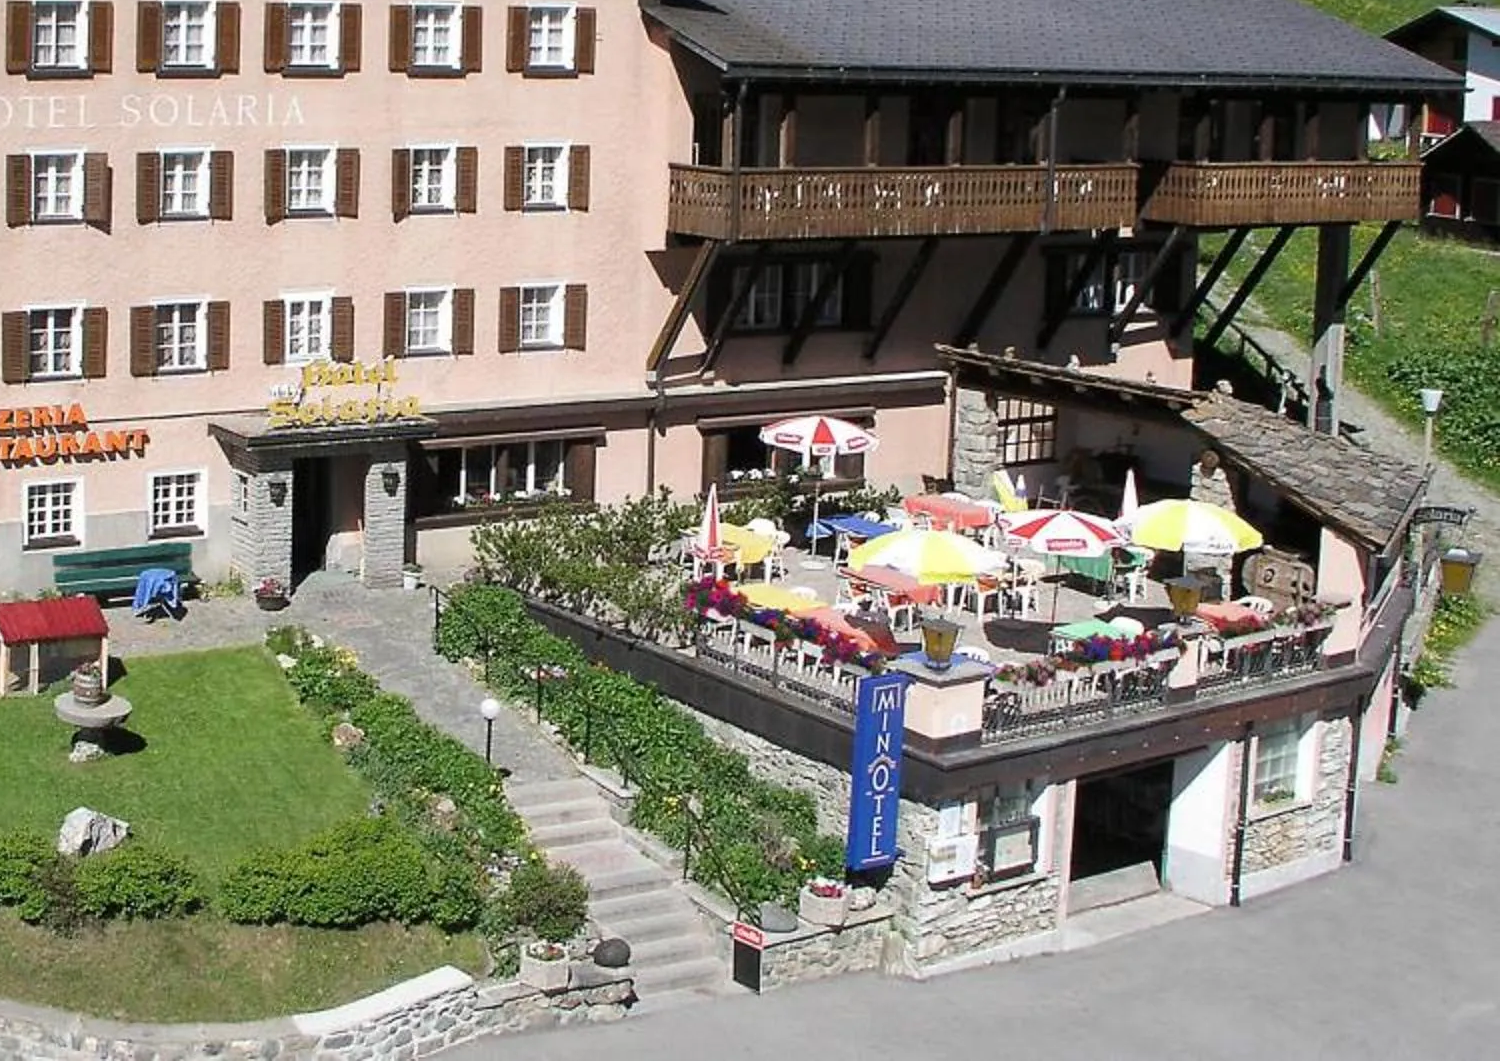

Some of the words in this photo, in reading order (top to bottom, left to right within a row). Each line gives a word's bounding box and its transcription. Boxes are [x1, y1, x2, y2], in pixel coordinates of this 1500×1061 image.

[120, 93, 305, 128] SOLARIA
[301, 354, 396, 386] Hotel
[870, 689, 897, 857] MINOTEL
